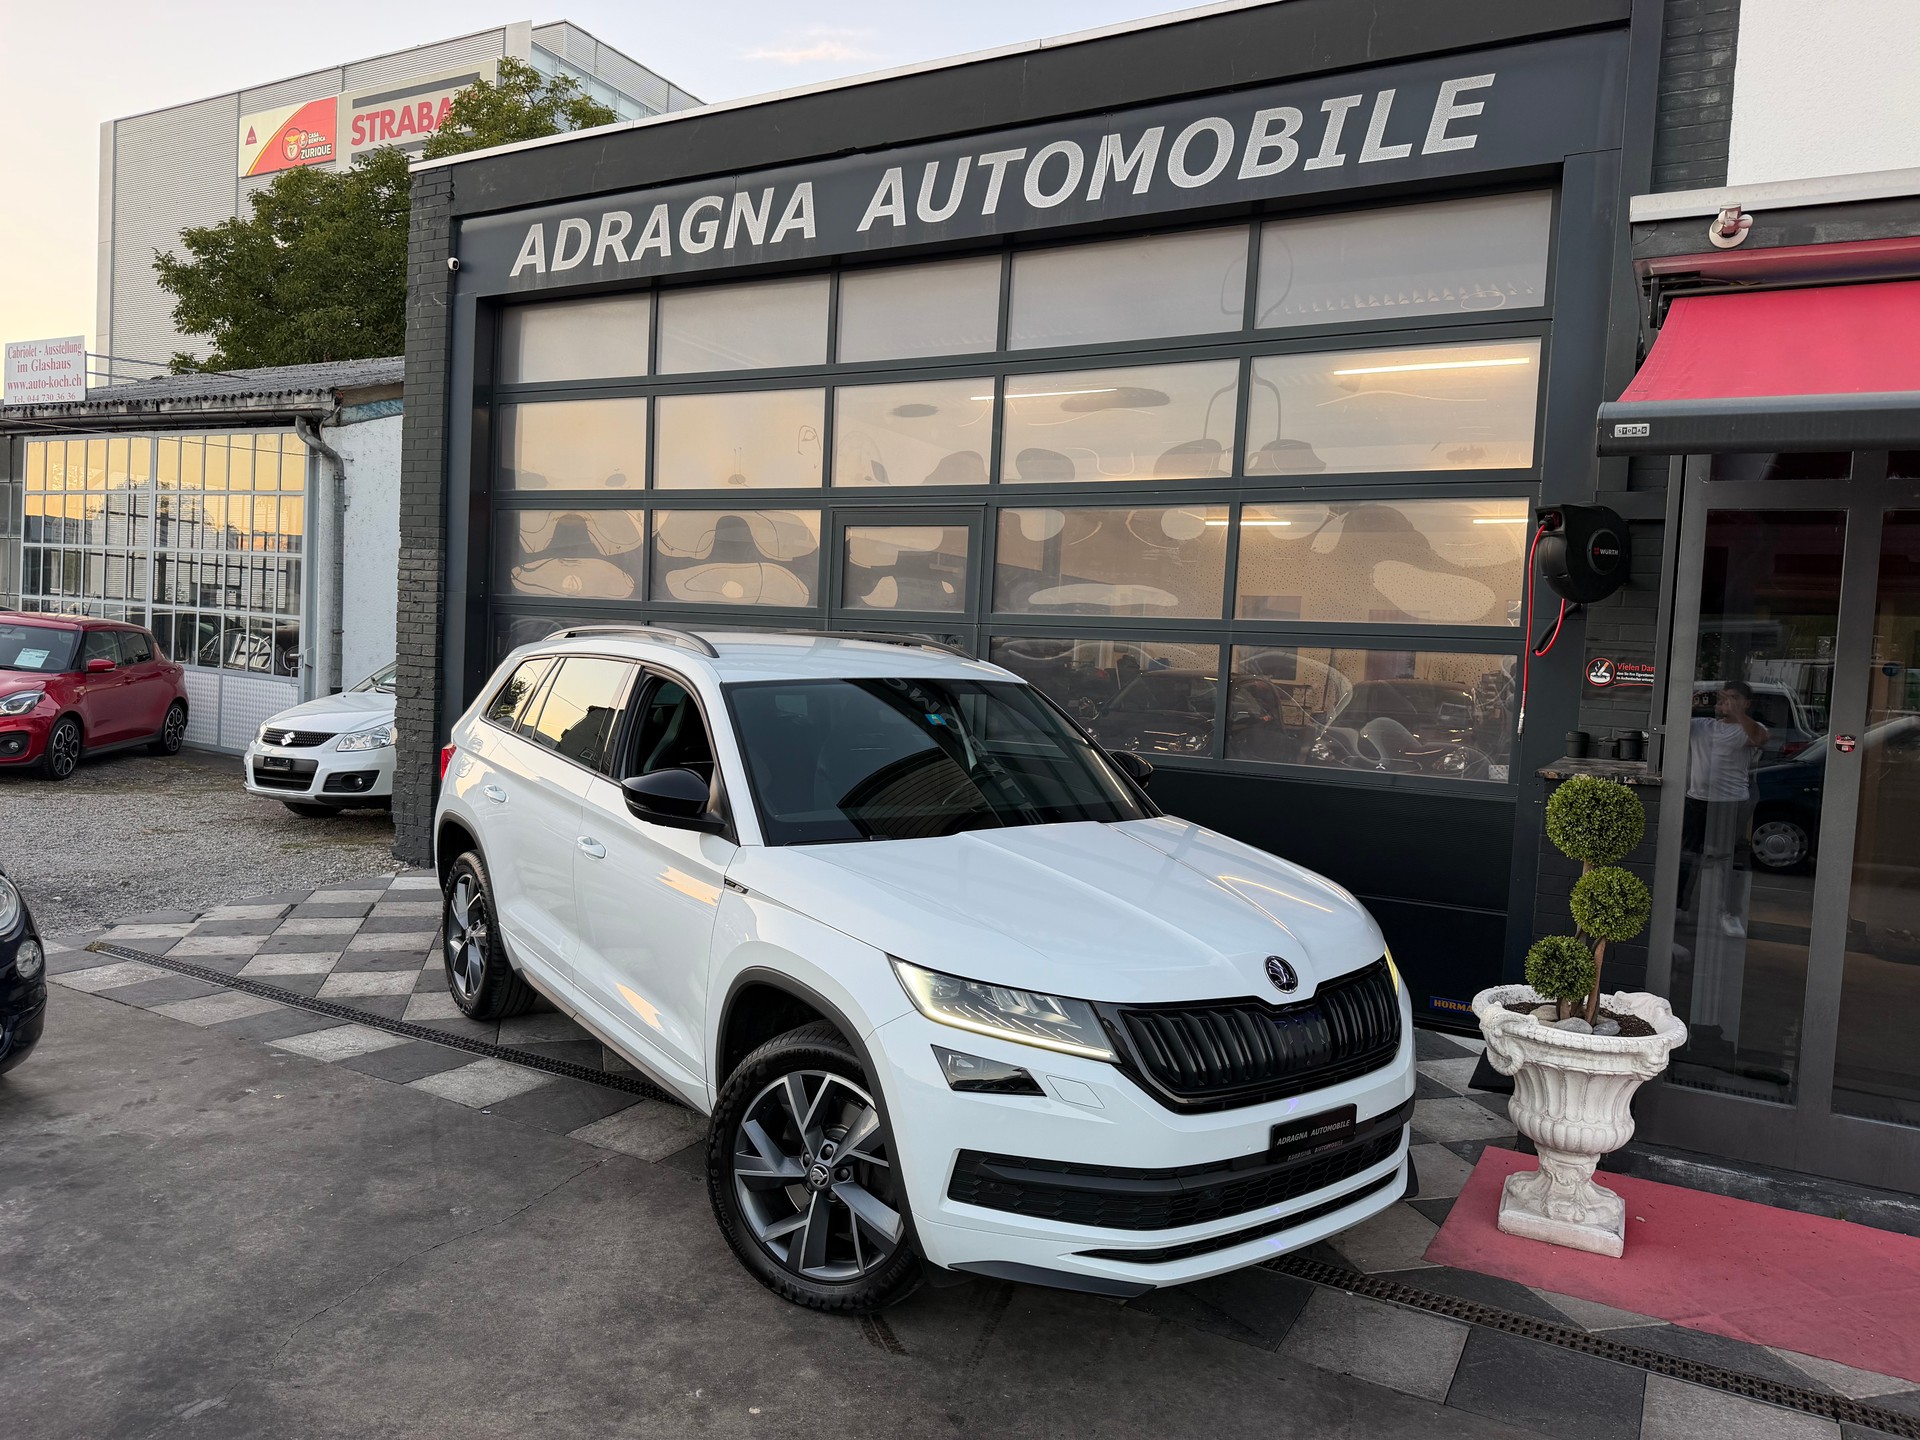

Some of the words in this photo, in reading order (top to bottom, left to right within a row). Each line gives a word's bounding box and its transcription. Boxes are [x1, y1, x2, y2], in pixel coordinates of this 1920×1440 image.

[351, 97, 454, 146] STRABA
[300, 144, 332, 160] ZURIQUE
[509, 181, 817, 278] ADRAGNA
[857, 73, 1496, 232] AUTOMOBILE
[8, 345, 37, 359] Cabriolet
[44, 341, 82, 356] Ausstellung
[17, 361, 28, 373] im
[31, 358, 71, 372] Glashaus
[8, 374, 82, 391] www.auto-koch.ch
[27, 394, 40, 402] 044
[42, 393, 54, 401] 730
[67, 392, 76, 400] 36
[1617, 663, 1640, 671] Vielen
[1641, 664, 1656, 672] Dan
[1277, 1131, 1308, 1146] ADRAGNA
[1310, 1119, 1351, 1137] AUTOMOBILE
